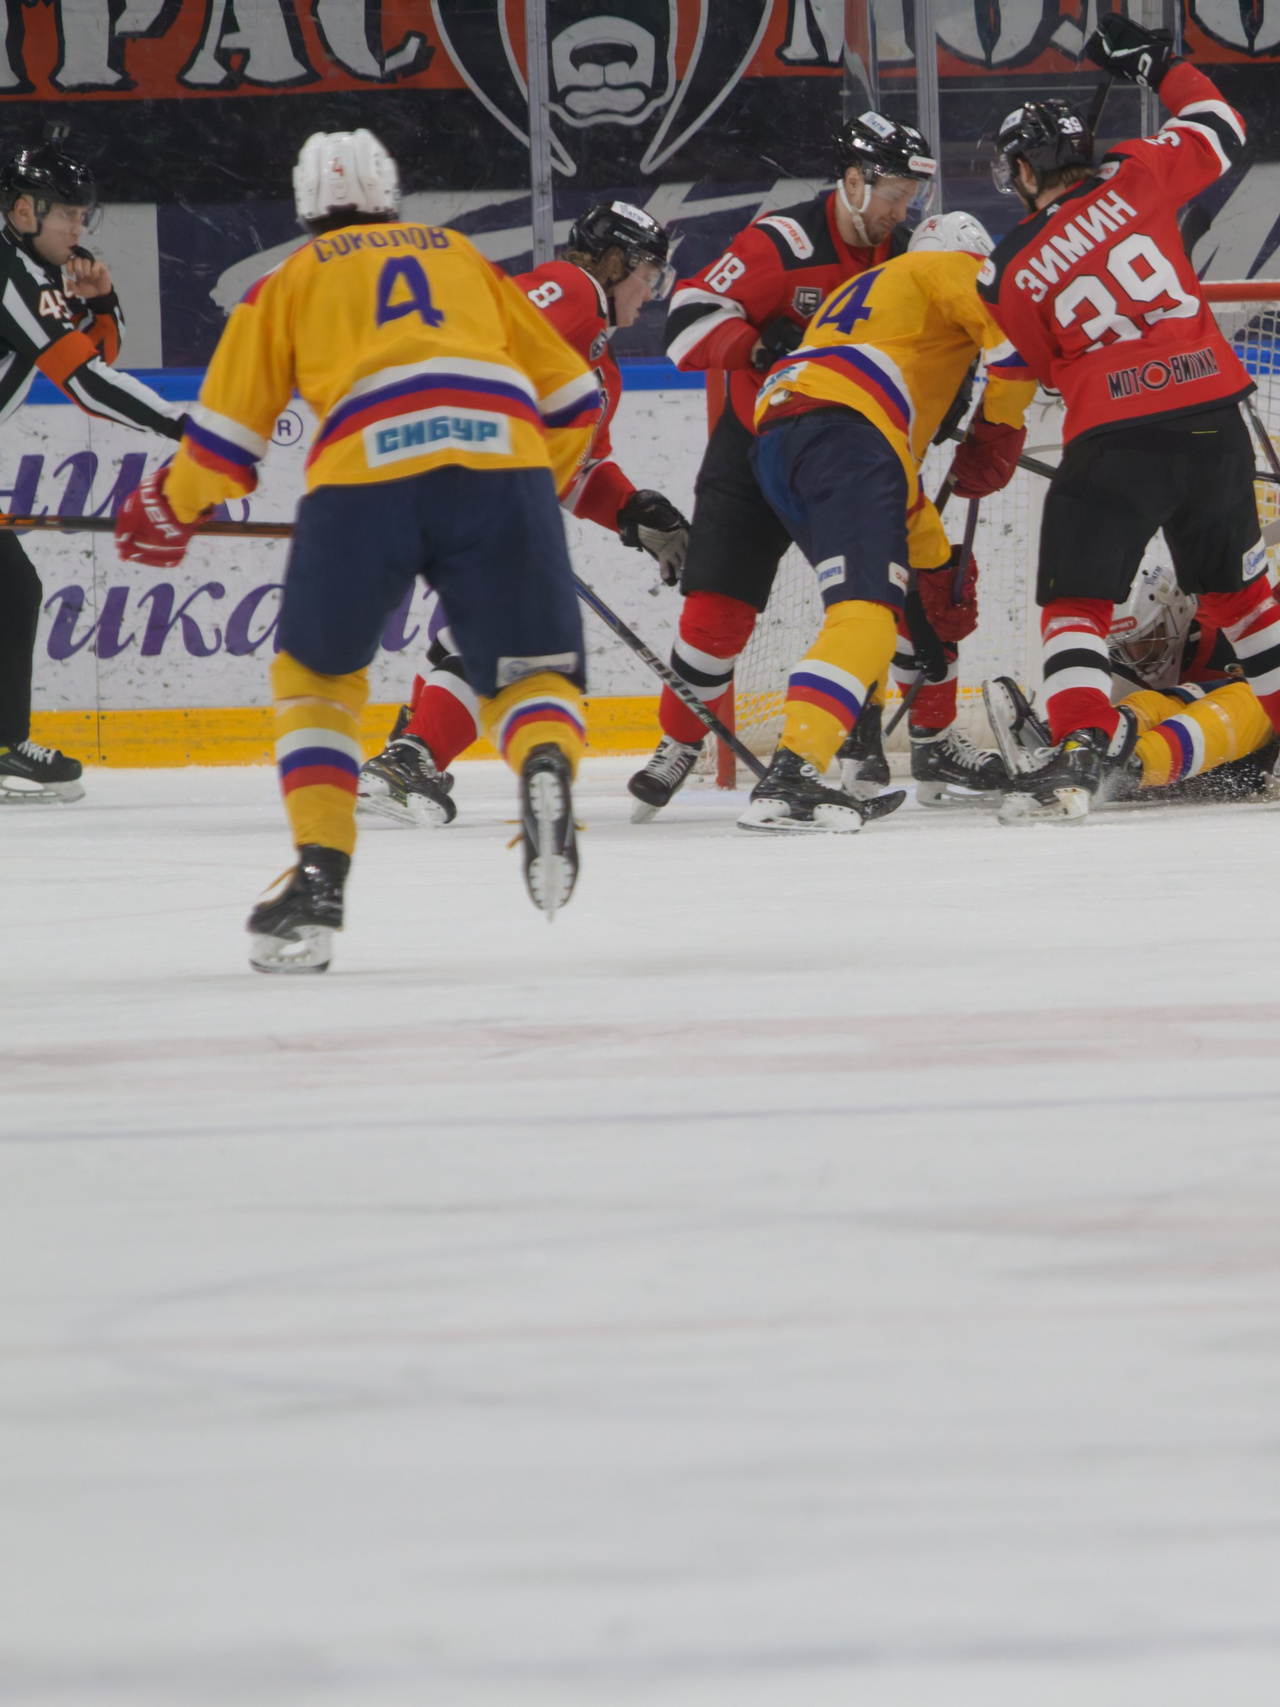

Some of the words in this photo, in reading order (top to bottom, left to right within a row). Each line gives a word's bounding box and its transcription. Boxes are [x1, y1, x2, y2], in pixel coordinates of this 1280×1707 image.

[1058, 117, 1083, 134] 39
[332, 157, 344, 178] 4
[313, 226, 451, 263] СОКОЛОВ
[1014, 190, 1138, 303] ЗИМИН
[376, 255, 445, 329] 4
[703, 252, 746, 294] 18
[1054, 232, 1200, 353] 39
[528, 281, 563, 309] 8
[376, 416, 499, 455] СИБУР
